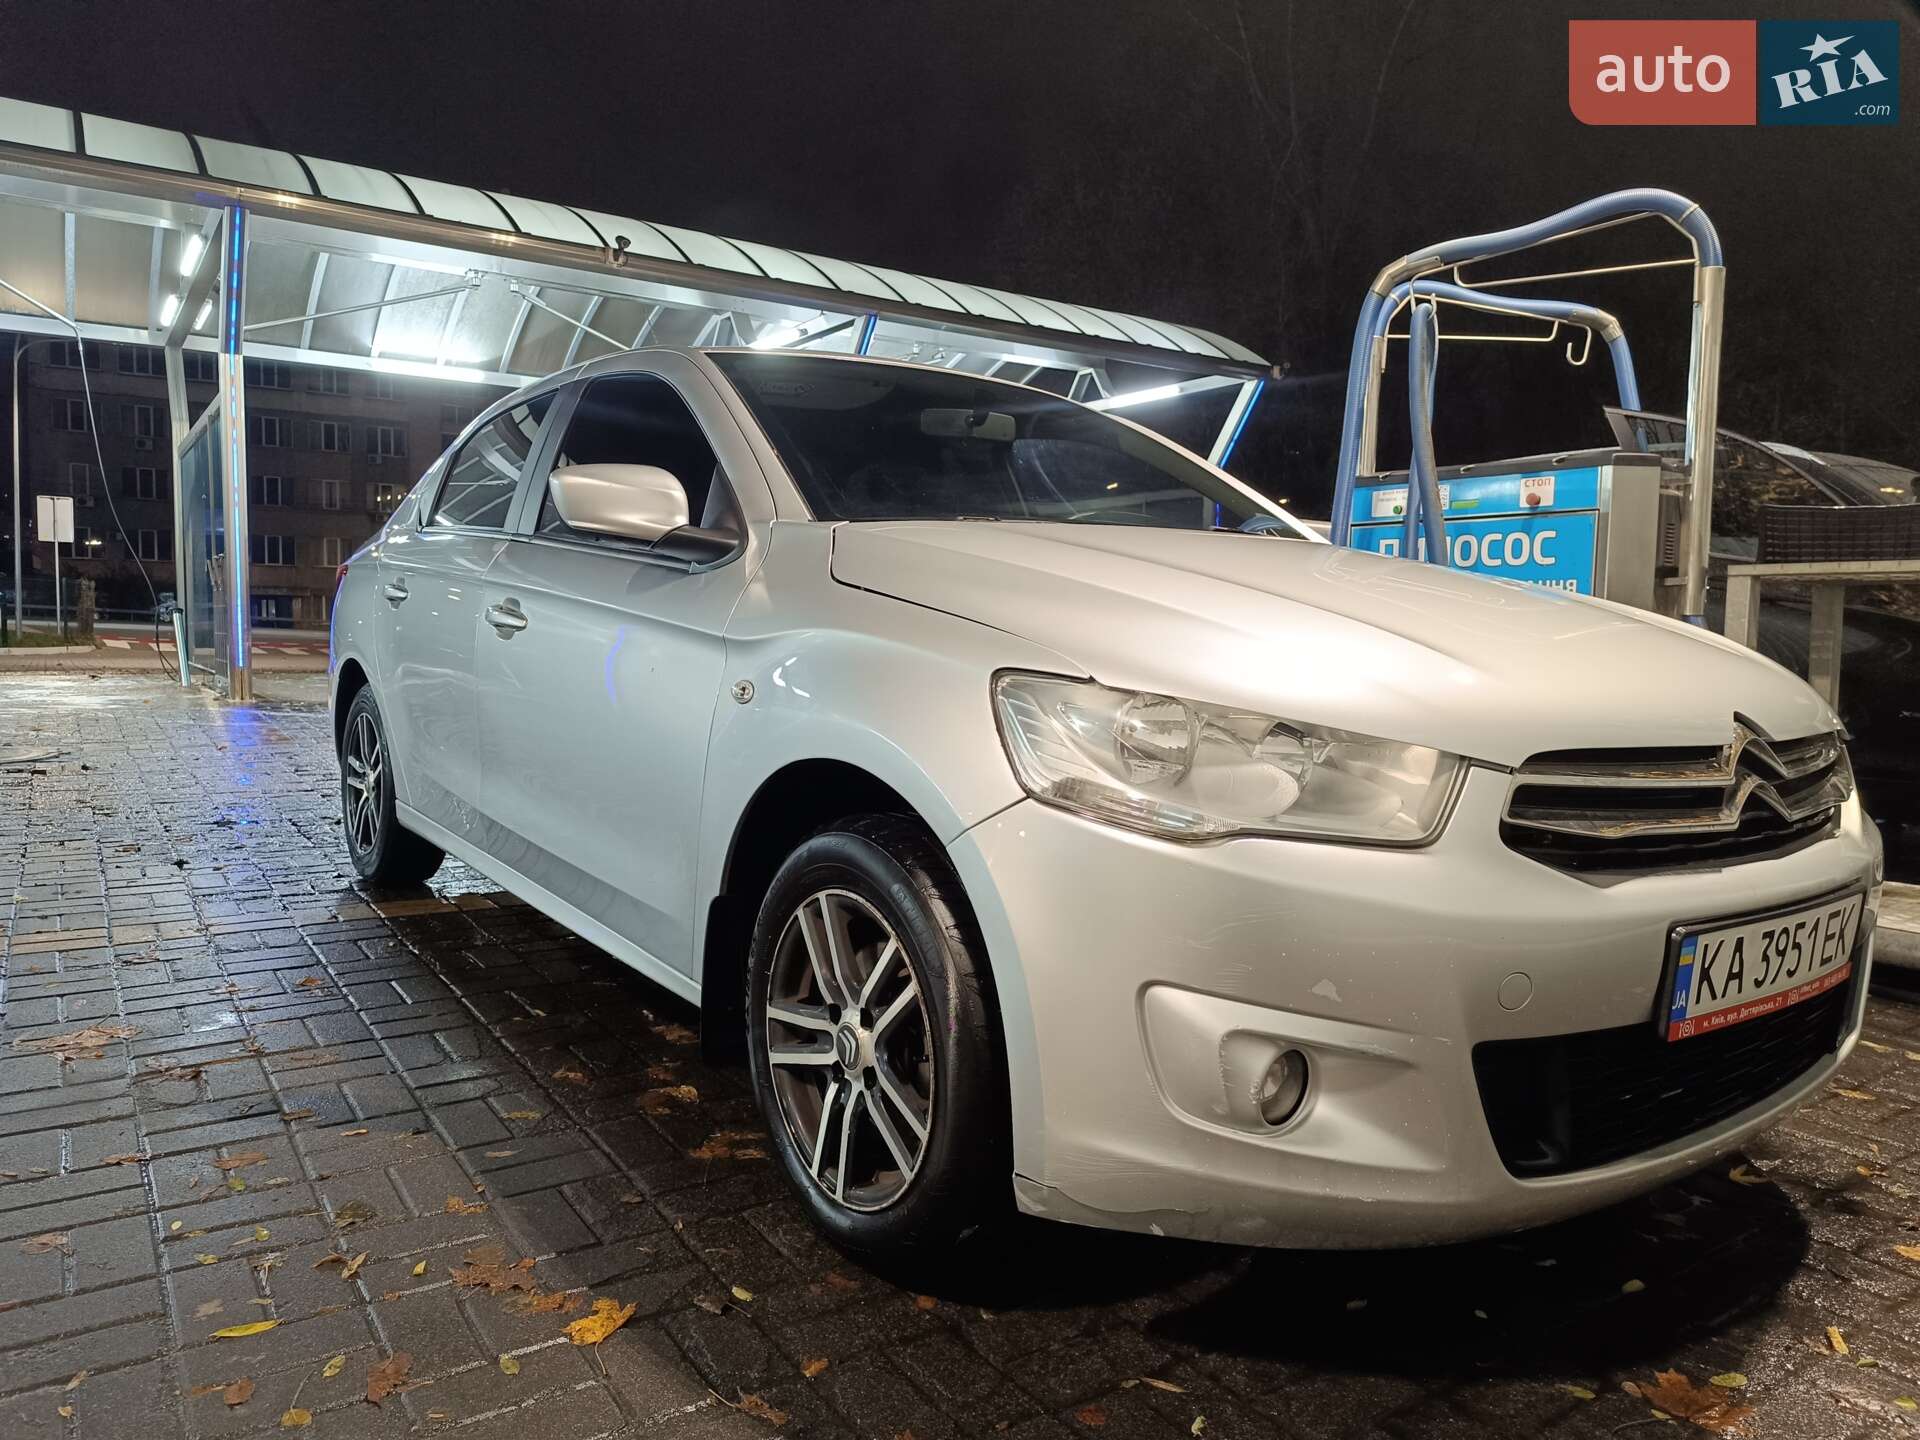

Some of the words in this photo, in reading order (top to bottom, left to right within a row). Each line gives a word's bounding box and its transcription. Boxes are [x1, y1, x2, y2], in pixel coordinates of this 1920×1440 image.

[1524, 478, 1551, 488] СТОП
[1379, 530, 1558, 569] ПОСОС
[1695, 936, 1745, 1005] KA
